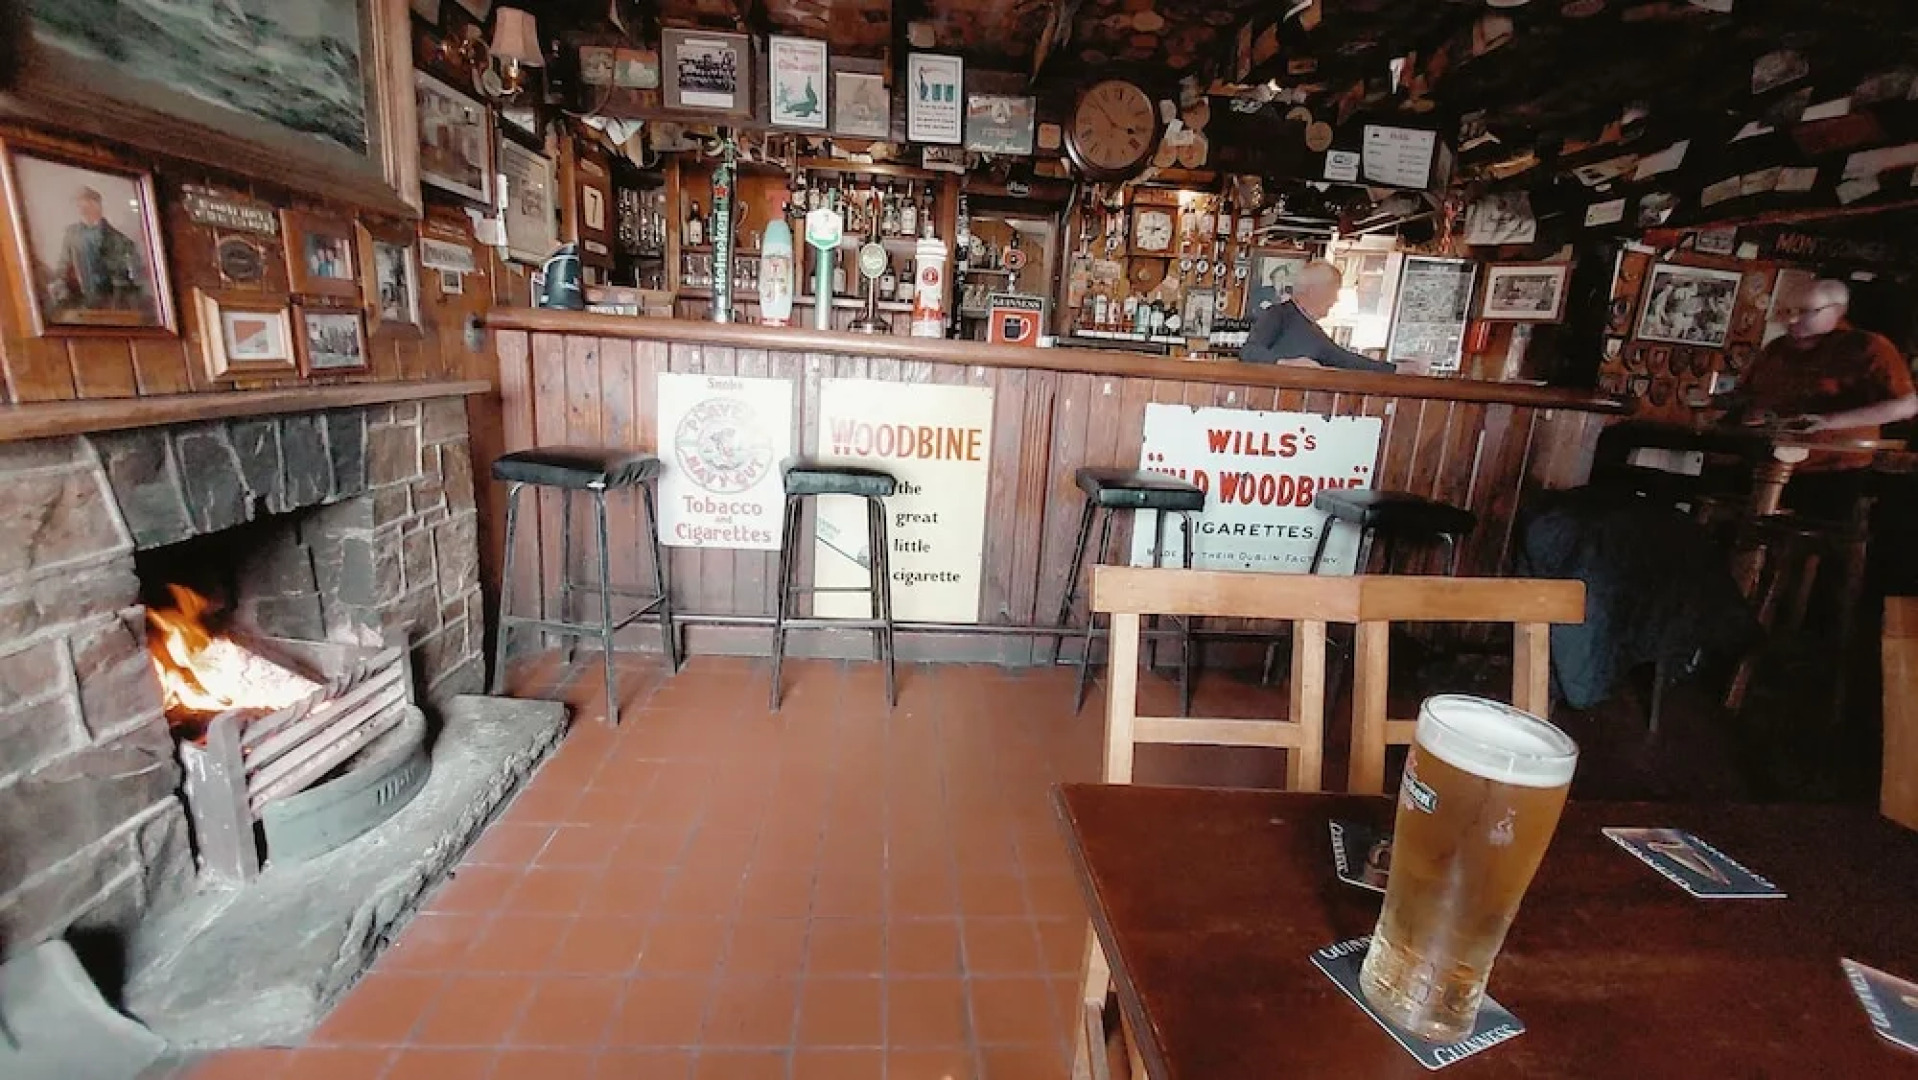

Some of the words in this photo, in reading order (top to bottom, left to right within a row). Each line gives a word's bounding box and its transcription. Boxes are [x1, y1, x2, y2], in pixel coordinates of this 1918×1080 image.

[714, 209, 730, 292] Heineken
[830, 418, 983, 462] WOODBINE
[897, 481, 922, 496] the
[683, 494, 763, 517] Tobacco
[715, 516, 733, 524] and
[895, 512, 938, 528] great
[675, 523, 772, 545] Cigarettes
[893, 538, 931, 553] little
[893, 568, 962, 587] cigarette
[1433, 1023, 1512, 1064] GUINNESS
